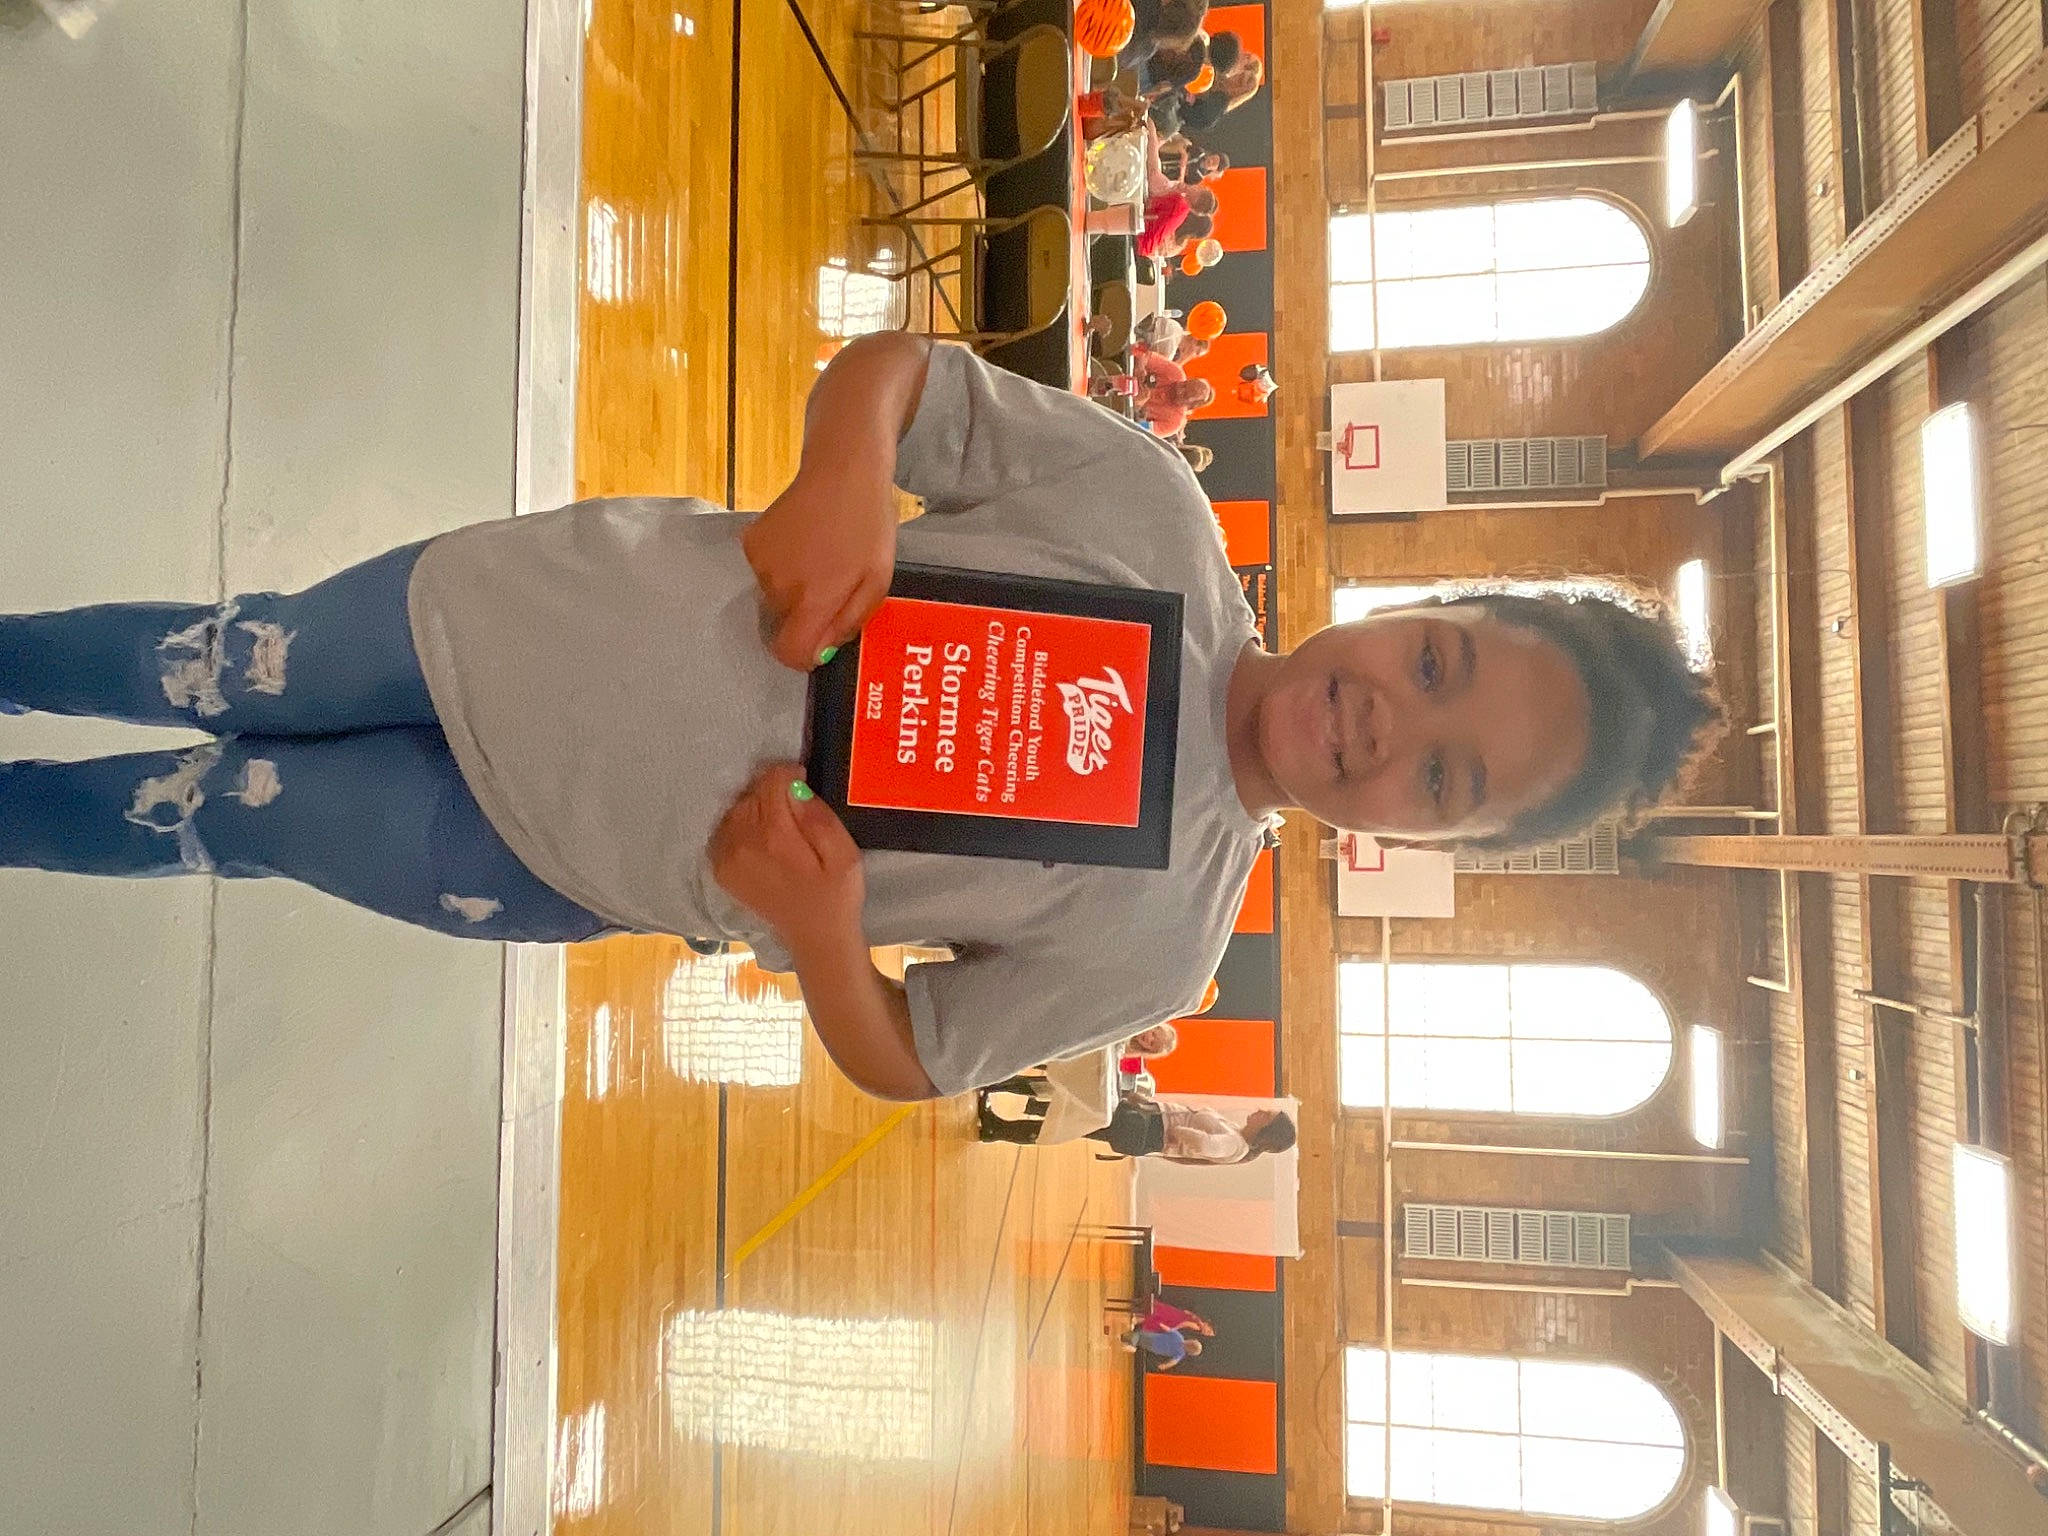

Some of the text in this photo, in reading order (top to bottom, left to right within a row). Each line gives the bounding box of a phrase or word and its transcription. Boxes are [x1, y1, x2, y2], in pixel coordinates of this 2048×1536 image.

[866, 682, 884, 720] 2022
[897, 643, 933, 764] Perkins
[934, 642, 971, 773] Stormee
[976, 621, 1006, 802] Cheering Tiger Cats
[1001, 626, 1031, 803] Competition Cheering
[1025, 651, 1048, 781] Biddeford Youth
[1068, 693, 1086, 756] PRIDE
[1076, 666, 1133, 770] Tiger
